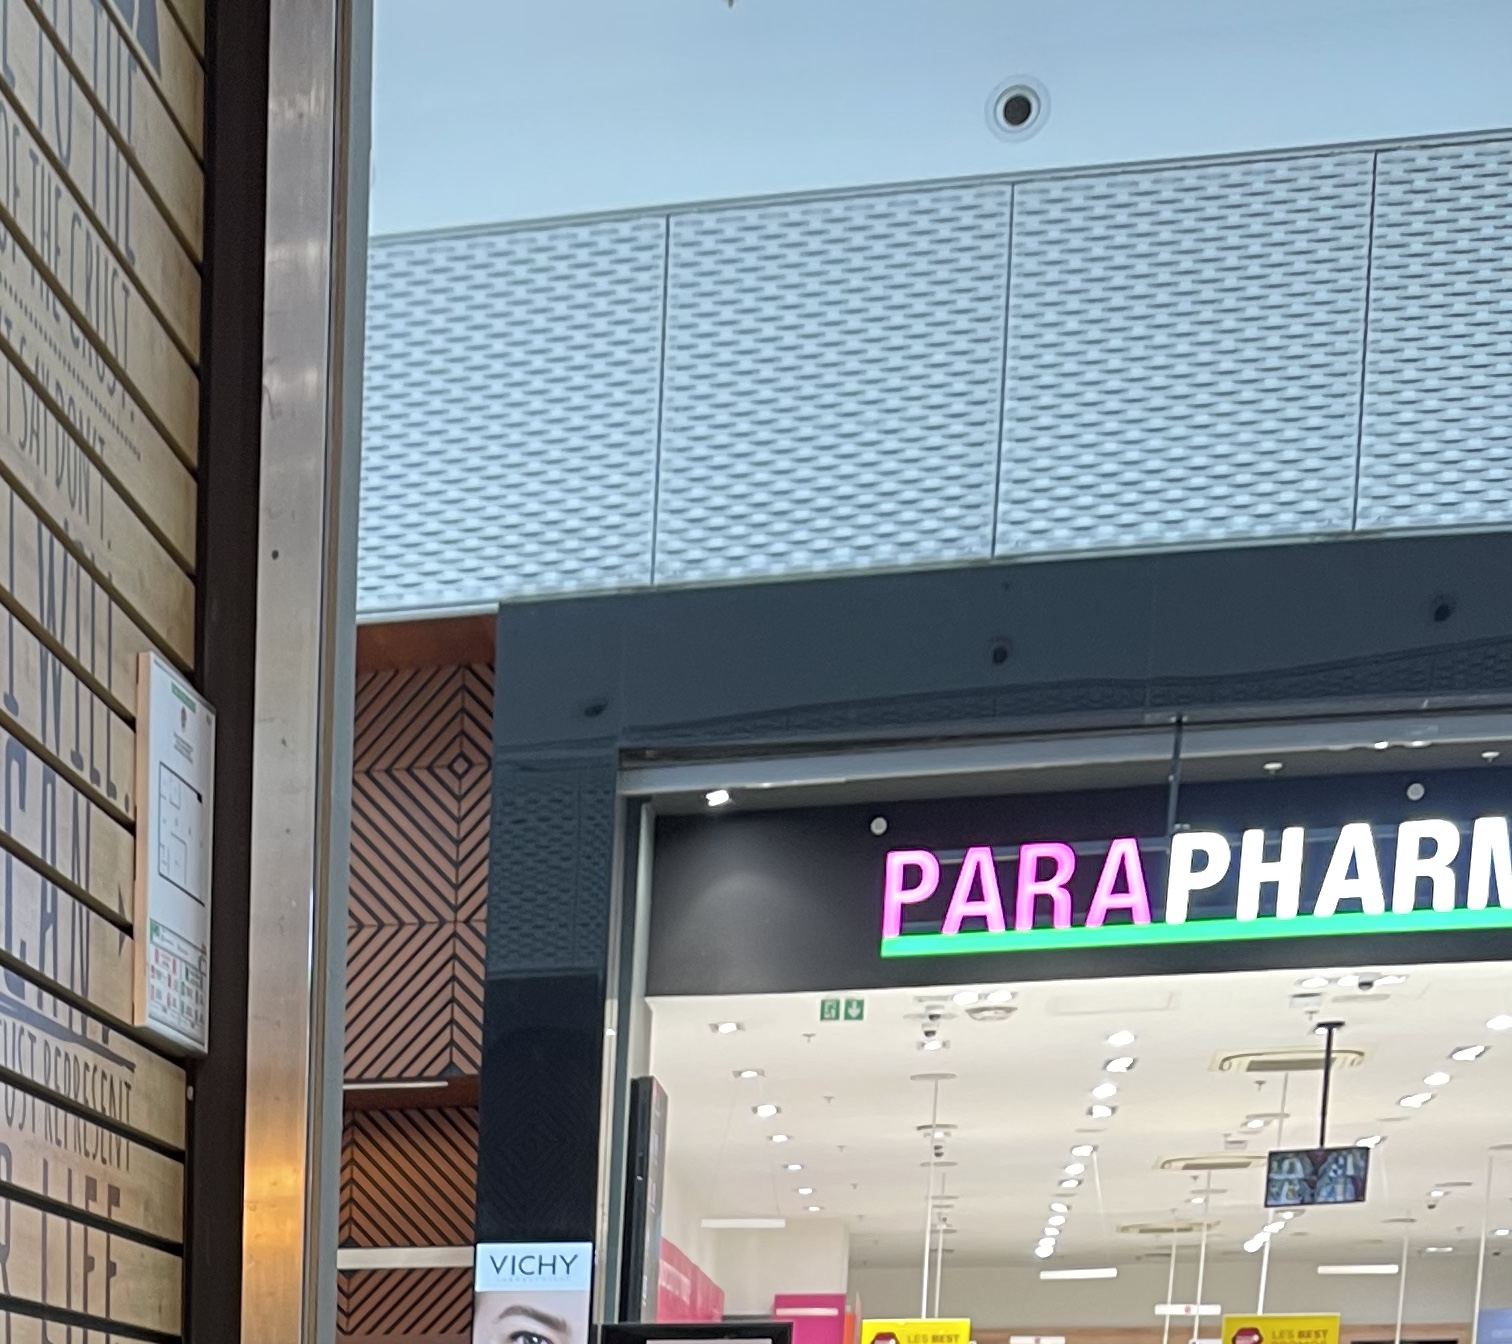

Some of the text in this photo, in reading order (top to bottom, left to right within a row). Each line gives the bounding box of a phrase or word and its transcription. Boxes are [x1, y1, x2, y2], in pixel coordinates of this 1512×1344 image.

[29, 146, 62, 323] THE
[43, 1038, 133, 1173] REPRESENT
[490, 1253, 579, 1276] VICHY
